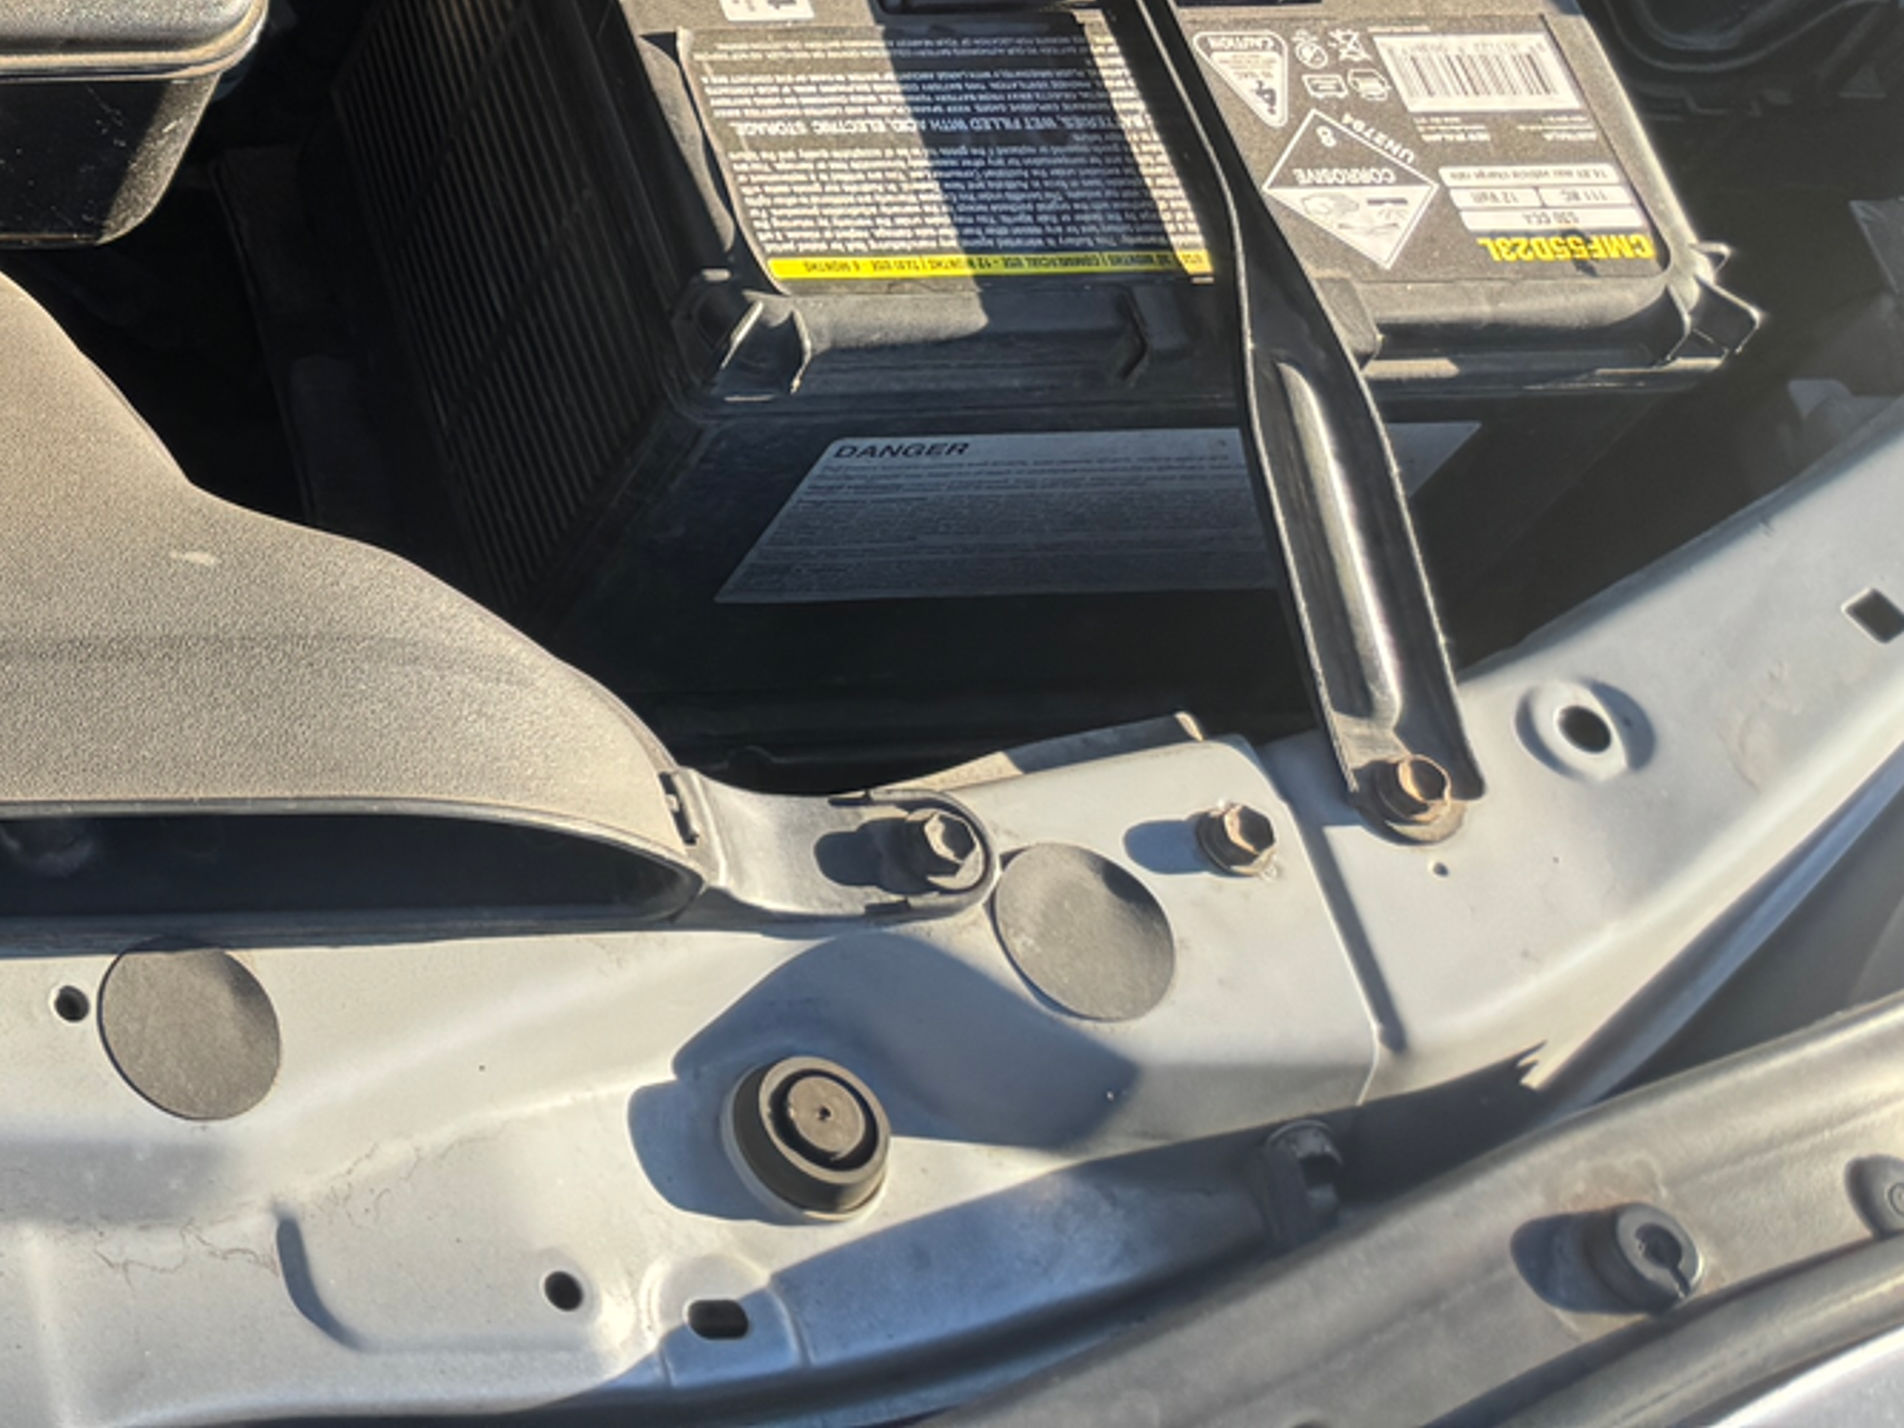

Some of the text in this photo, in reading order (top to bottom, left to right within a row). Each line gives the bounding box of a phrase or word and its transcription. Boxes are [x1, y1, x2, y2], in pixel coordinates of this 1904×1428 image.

[812, 119, 885, 135] ELECTRIC
[930, 118, 968, 132] WITH
[971, 117, 1022, 132] FILLED
[1025, 117, 1056, 130] WET
[1315, 126, 1338, 148] 8
[1293, 167, 1396, 185] CORROSIVE
[1477, 233, 1655, 261] CMF55D23L
[833, 440, 972, 460] DANGER
